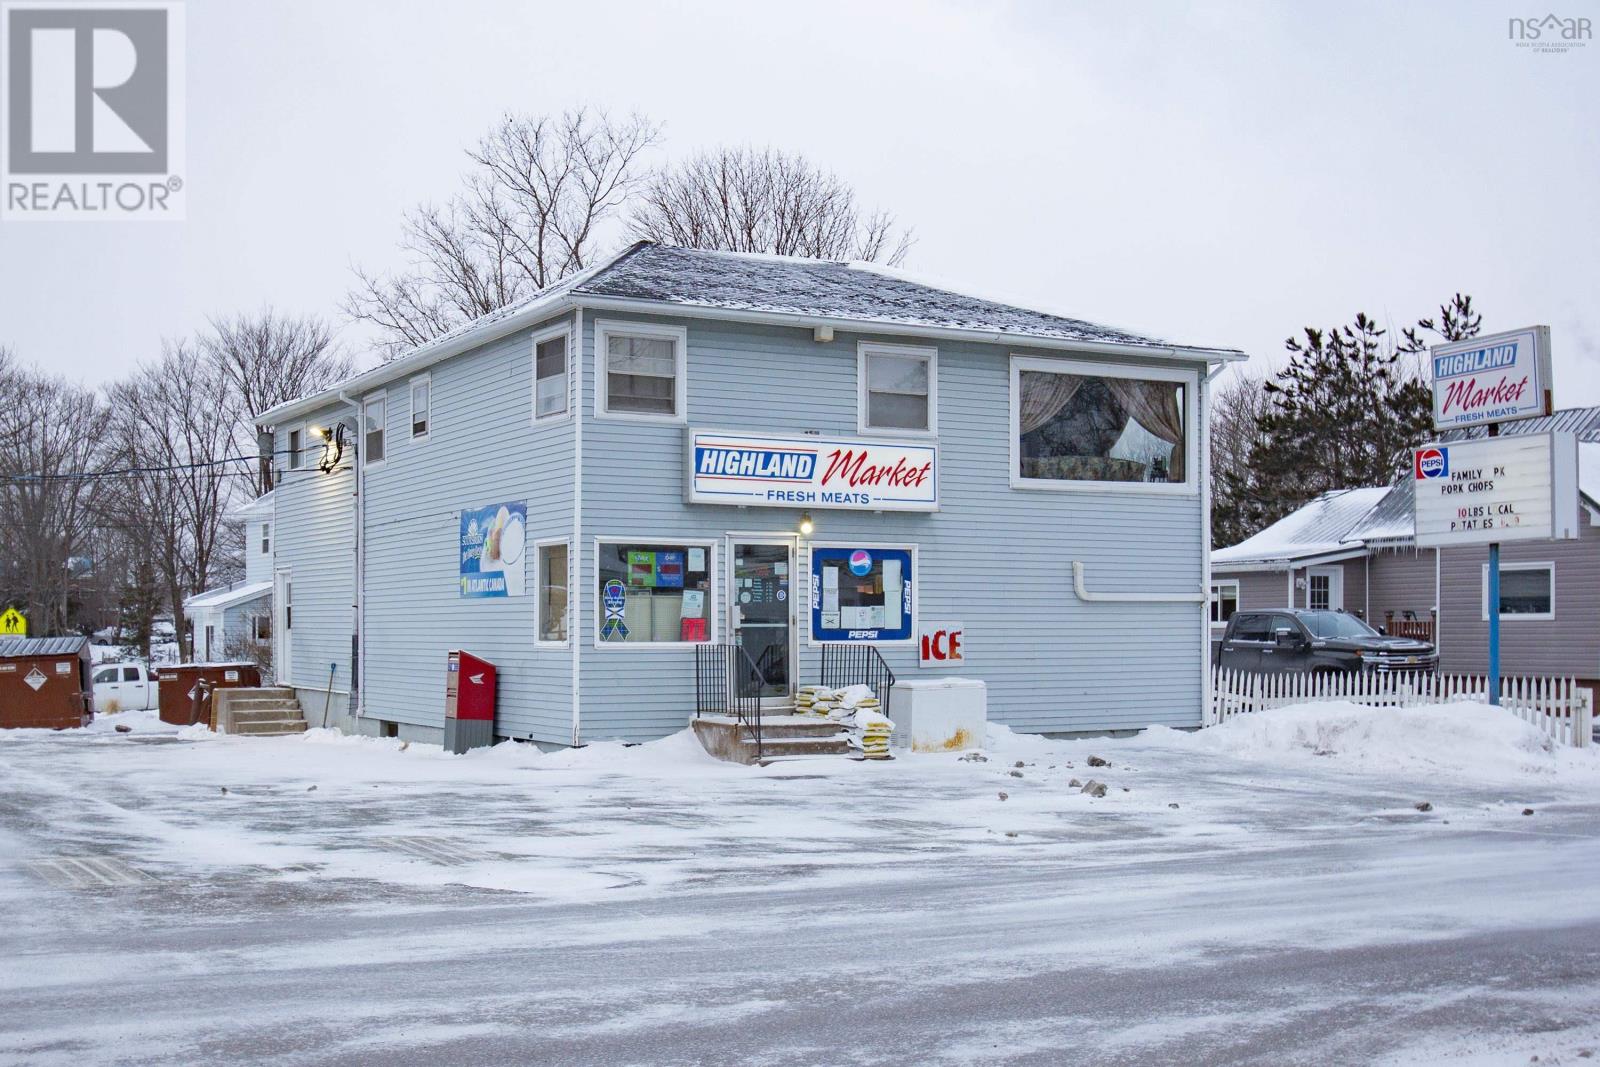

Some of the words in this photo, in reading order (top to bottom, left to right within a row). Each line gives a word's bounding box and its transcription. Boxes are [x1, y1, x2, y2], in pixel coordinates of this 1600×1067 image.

[1438, 345, 1514, 377] HIGHLAND
[1442, 375, 1529, 415] Market
[1455, 411, 1484, 423] FRESH
[1486, 406, 1518, 418] MEATS
[700, 449, 815, 479] HIGHLAND
[821, 449, 932, 488] Market
[1421, 458, 1444, 468] PEPSI
[1451, 469, 1483, 482] FAMILY
[767, 490, 816, 502] FRESH
[821, 492, 870, 504] MEATS
[1441, 485, 1464, 496] PORK
[812, 574, 820, 610] PEPSI
[904, 580, 912, 615] PEPSI
[848, 630, 879, 639] PEPSI
[921, 630, 962, 661] ICE
